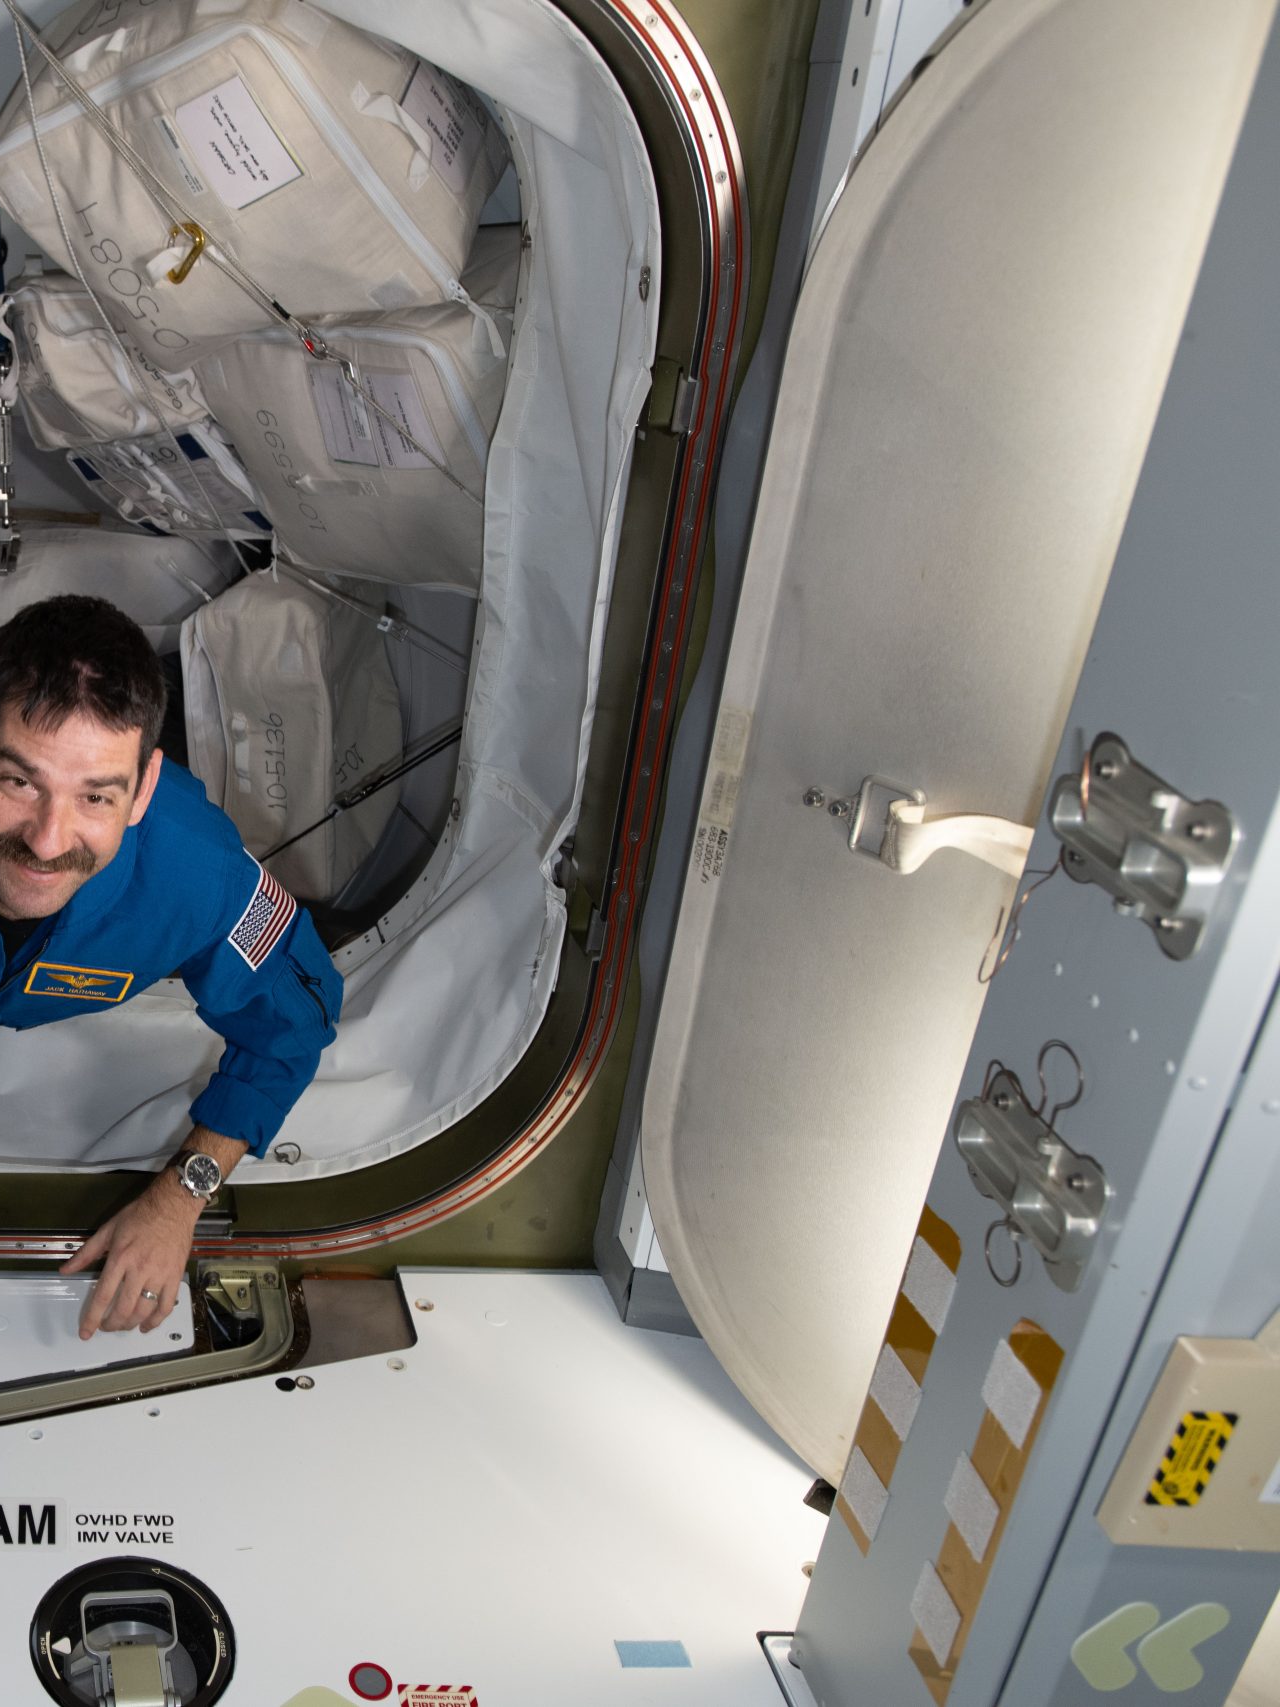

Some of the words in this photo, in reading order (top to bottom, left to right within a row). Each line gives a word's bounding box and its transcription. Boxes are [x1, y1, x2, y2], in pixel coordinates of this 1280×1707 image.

[259, 712, 287, 816] 10-5136
[44, 985, 65, 993] JACK
[75, 1514, 127, 1526] OVHD
[133, 1514, 174, 1527] FWD
[77, 1531, 110, 1543] IMV
[115, 1531, 174, 1544] VALVE
[219, 1631, 227, 1658] CLOSED
